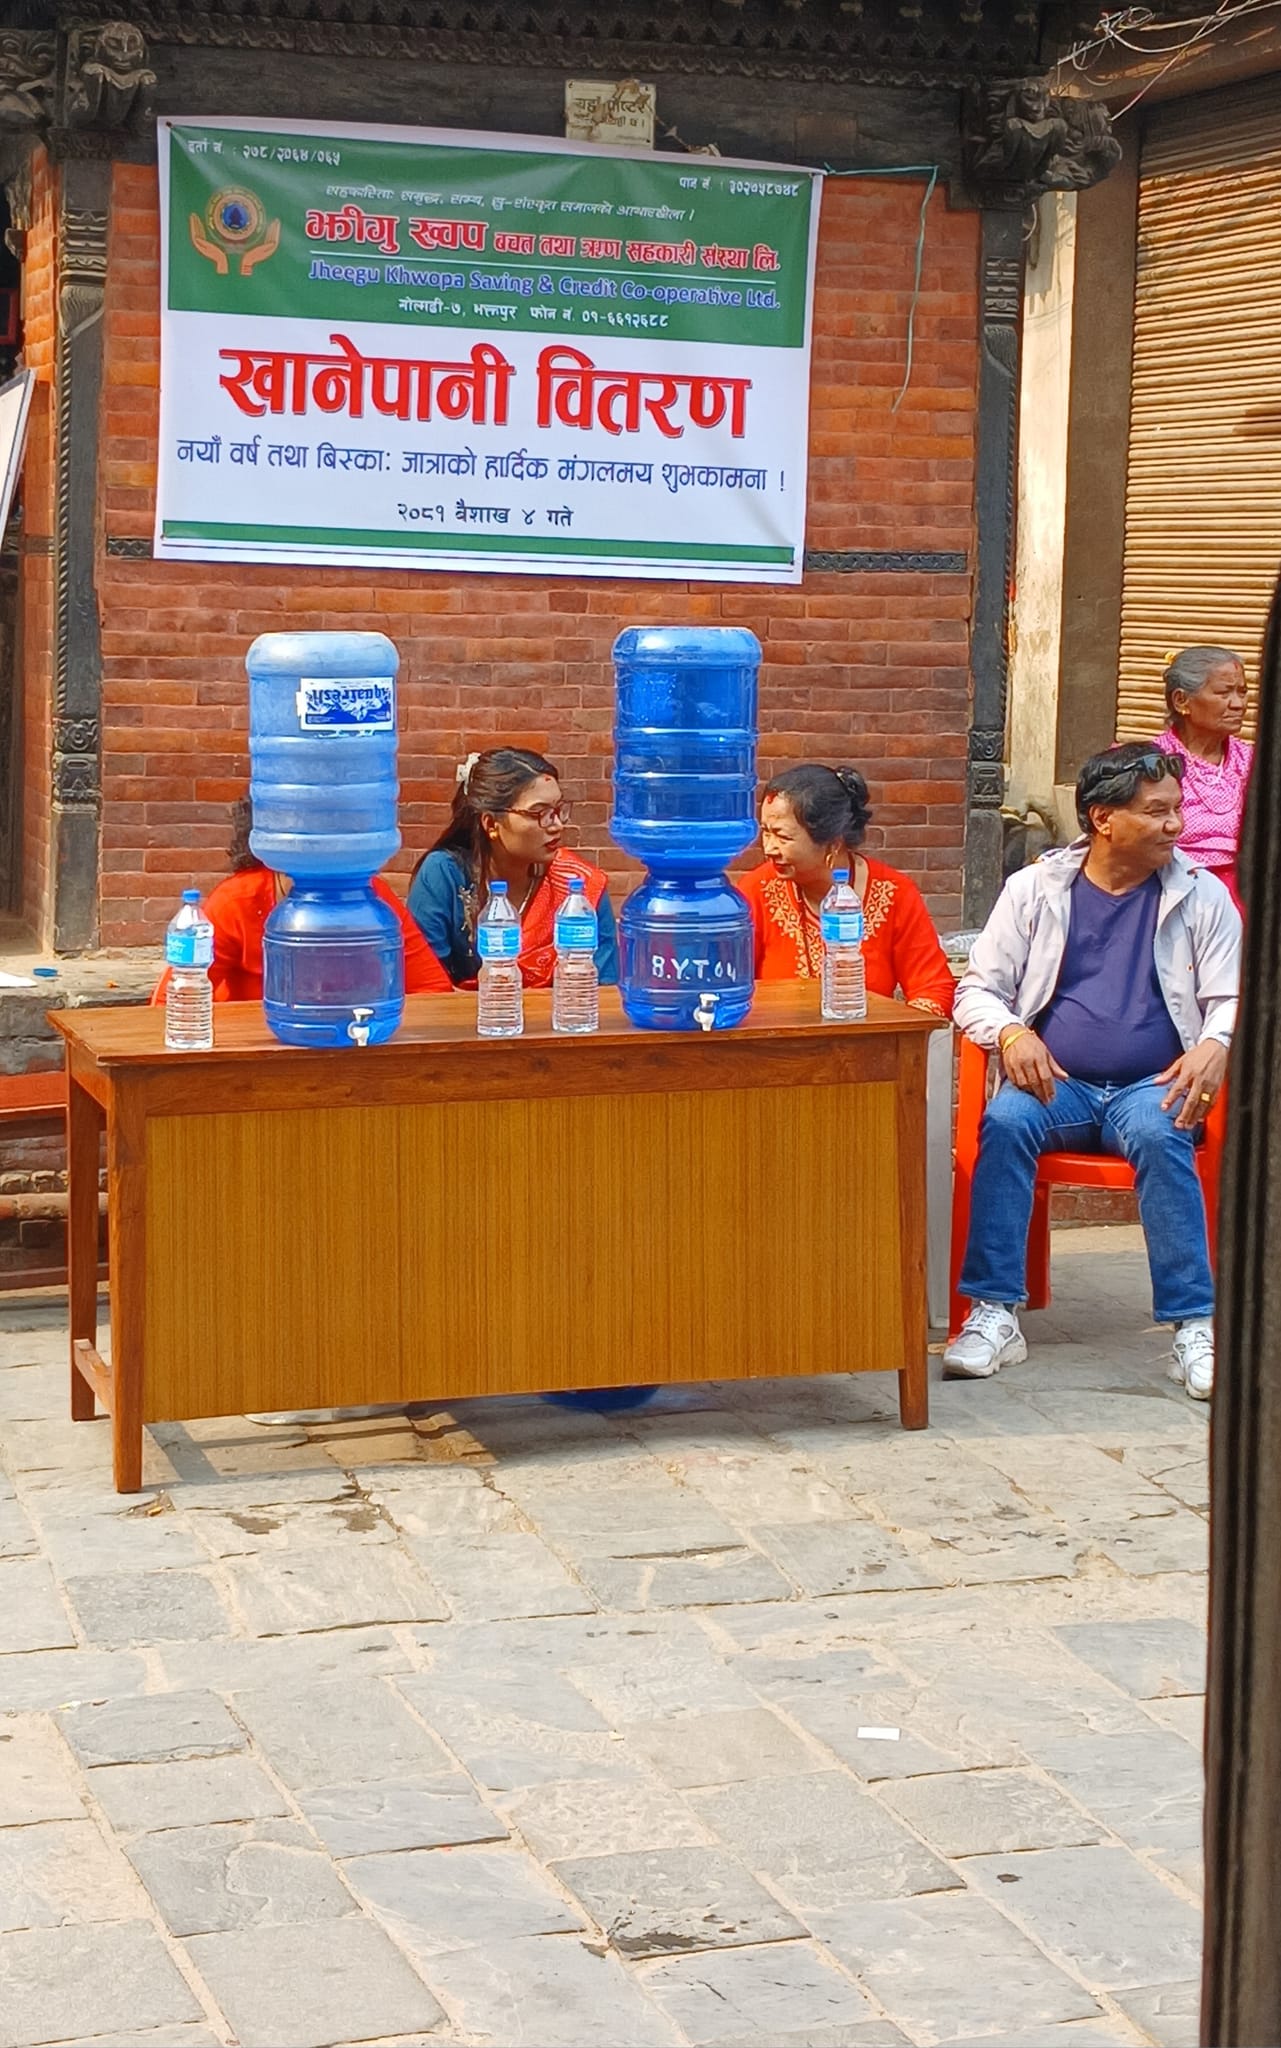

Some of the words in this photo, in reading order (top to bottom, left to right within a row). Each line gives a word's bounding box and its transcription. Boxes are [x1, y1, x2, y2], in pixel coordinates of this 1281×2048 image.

[305, 204, 400, 255] झीगु
[408, 216, 489, 252] ख्वप
[493, 231, 536, 257] बचत
[539, 234, 576, 258] तथा
[580, 237, 621, 261] ऋण
[626, 238, 697, 267] सहकारी
[701, 242, 749, 270] संस्था
[752, 243, 782, 272] लि.
[309, 259, 380, 287] Jheegu
[385, 265, 466, 291] Khwopa
[469, 271, 533, 298] Saving
[537, 276, 554, 295] &
[560, 276, 617, 299] Credit
[620, 280, 742, 307] Co-operative
[745, 288, 782, 310] Ltd.
[529, 304, 557, 320] फोन
[582, 310, 669, 329] ०१-६६१२६८८
[218, 333, 517, 425] खानेपानी
[536, 344, 753, 438] वितरण
[177, 435, 222, 464] नयाँ
[229, 434, 262, 467] वर्ष
[267, 443, 310, 469] तथा
[401, 446, 477, 476] जात्राको
[484, 448, 551, 482] हार्दिक
[557, 454, 655, 485] मंगलमय
[662, 461, 768, 494] शुभकामना
[779, 470, 786, 493] !
[397, 503, 445, 523] २०८१
[522, 508, 536, 526] ४
[546, 504, 575, 527] गते
